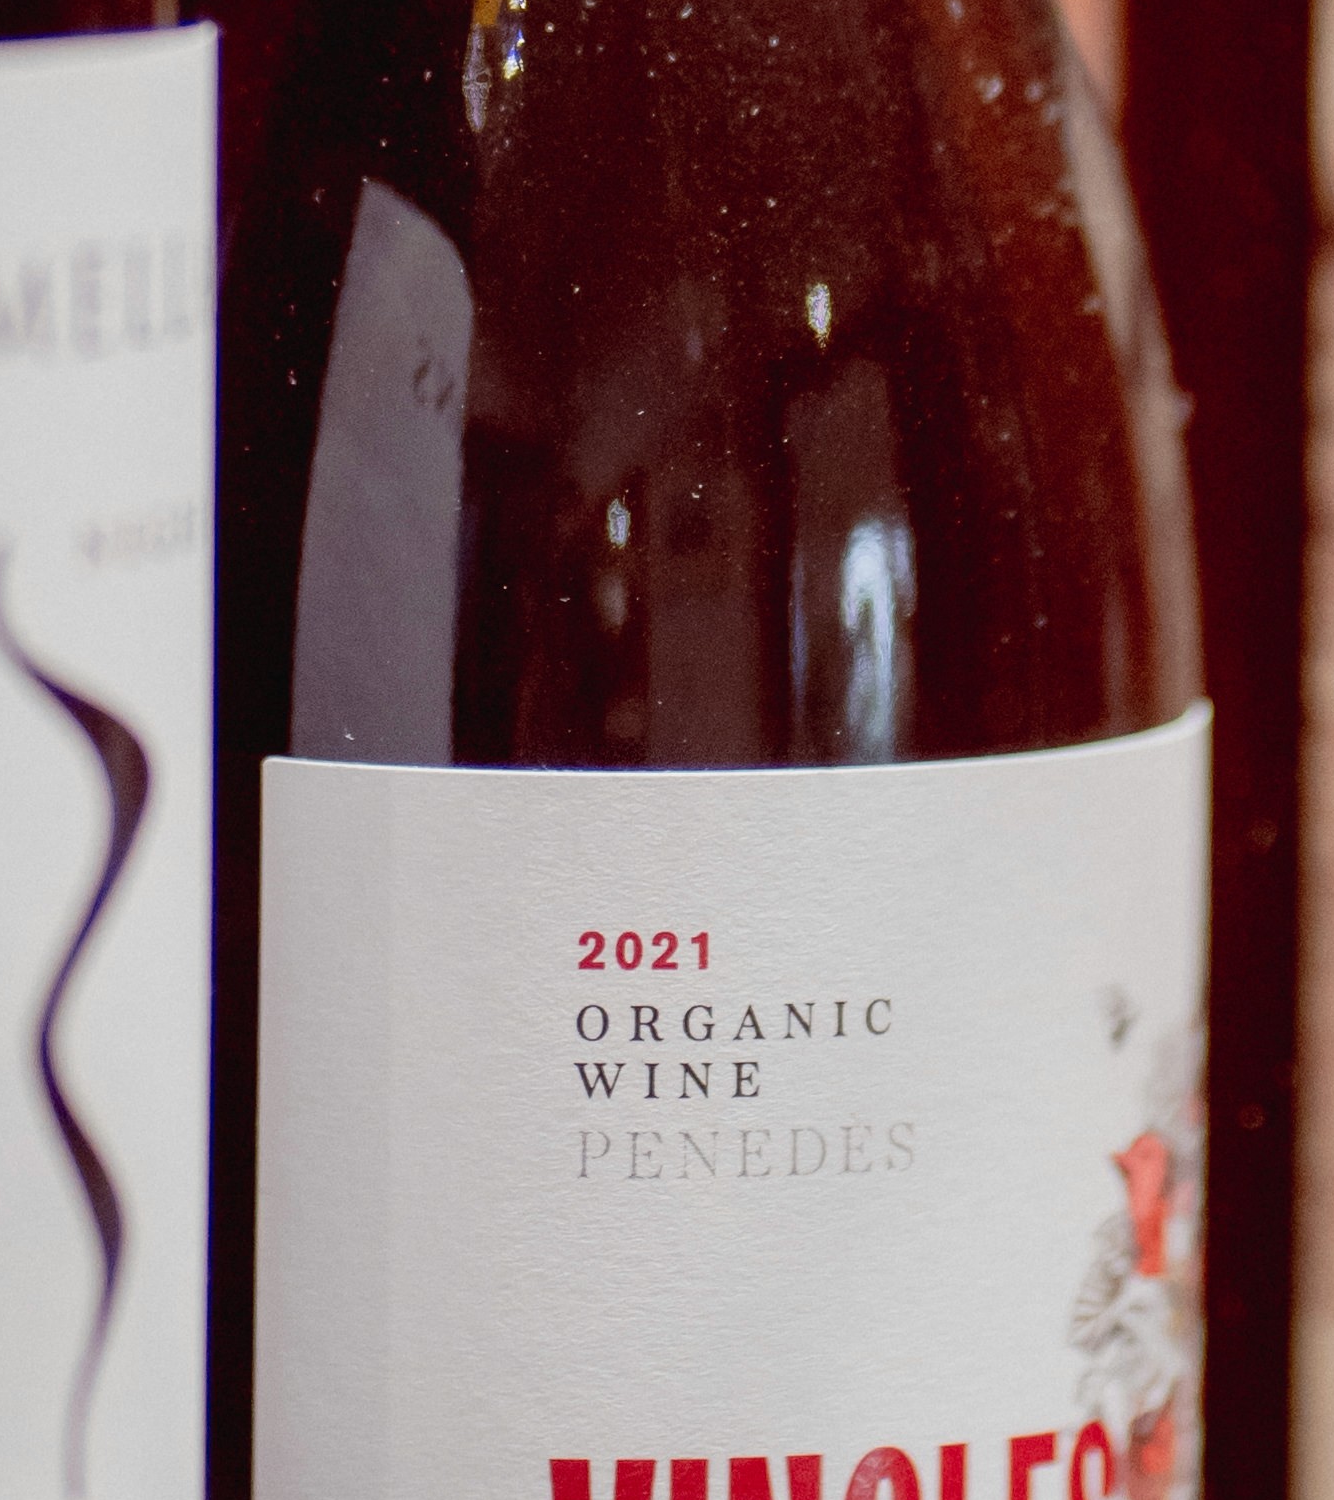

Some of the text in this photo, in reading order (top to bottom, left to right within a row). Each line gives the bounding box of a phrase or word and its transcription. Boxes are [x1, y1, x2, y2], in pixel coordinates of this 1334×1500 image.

[577, 930, 710, 971] 2021
[575, 998, 893, 1042] ORGANIC
[573, 1061, 761, 1100] WINE
